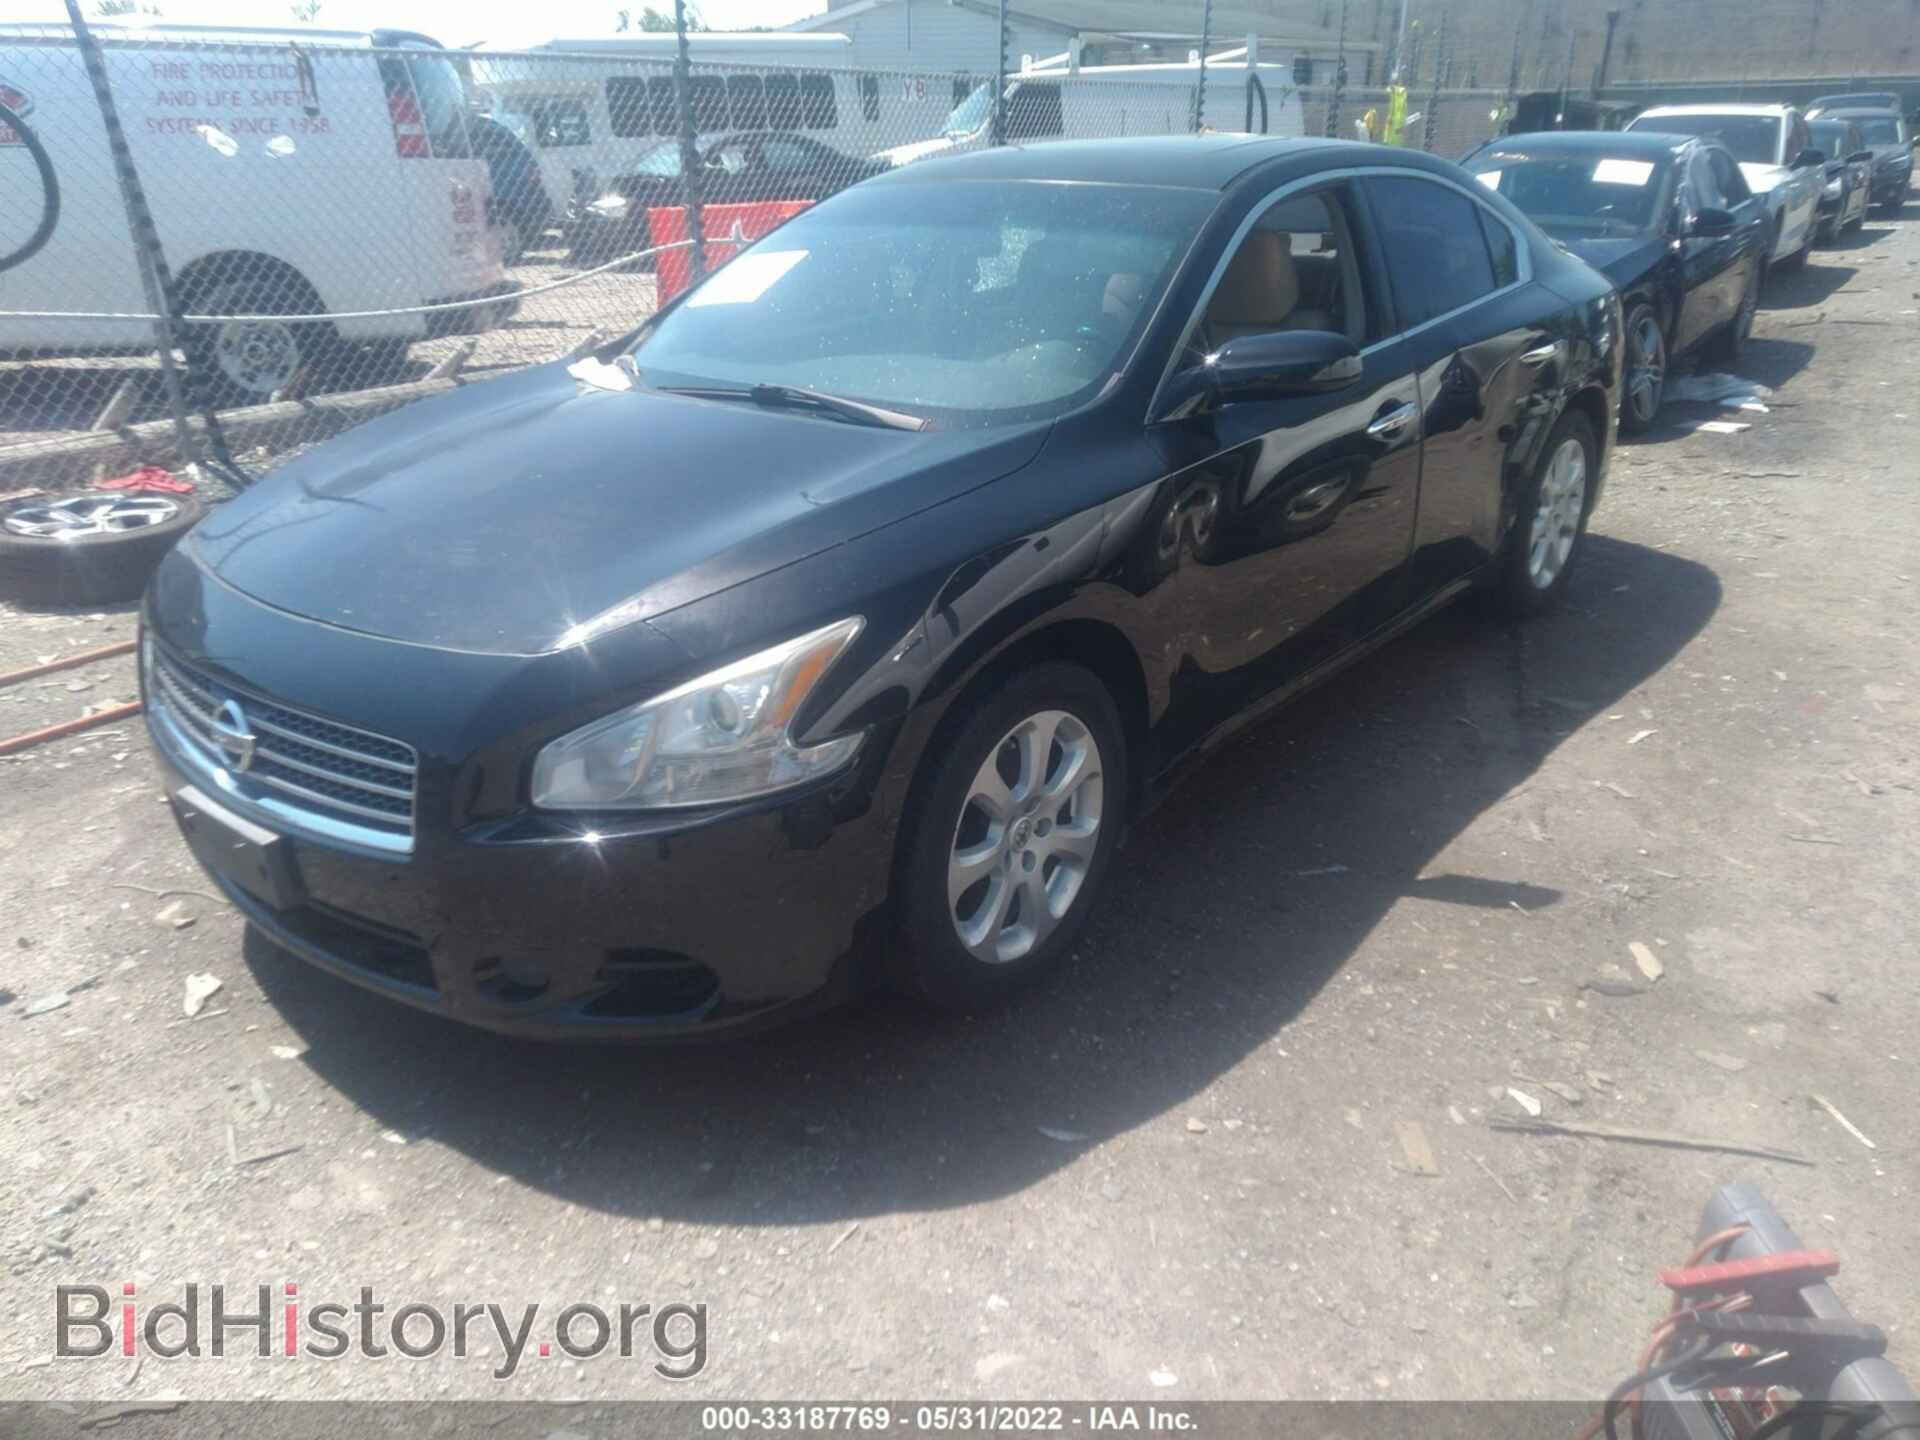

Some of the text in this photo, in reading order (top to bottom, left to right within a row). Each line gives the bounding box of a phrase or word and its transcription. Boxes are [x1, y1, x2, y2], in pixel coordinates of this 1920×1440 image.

[152, 63, 312, 80] FIRE PROTECTIO
[157, 90, 314, 108] AND LIFE SAFET
[231, 117, 279, 134] SINCE
